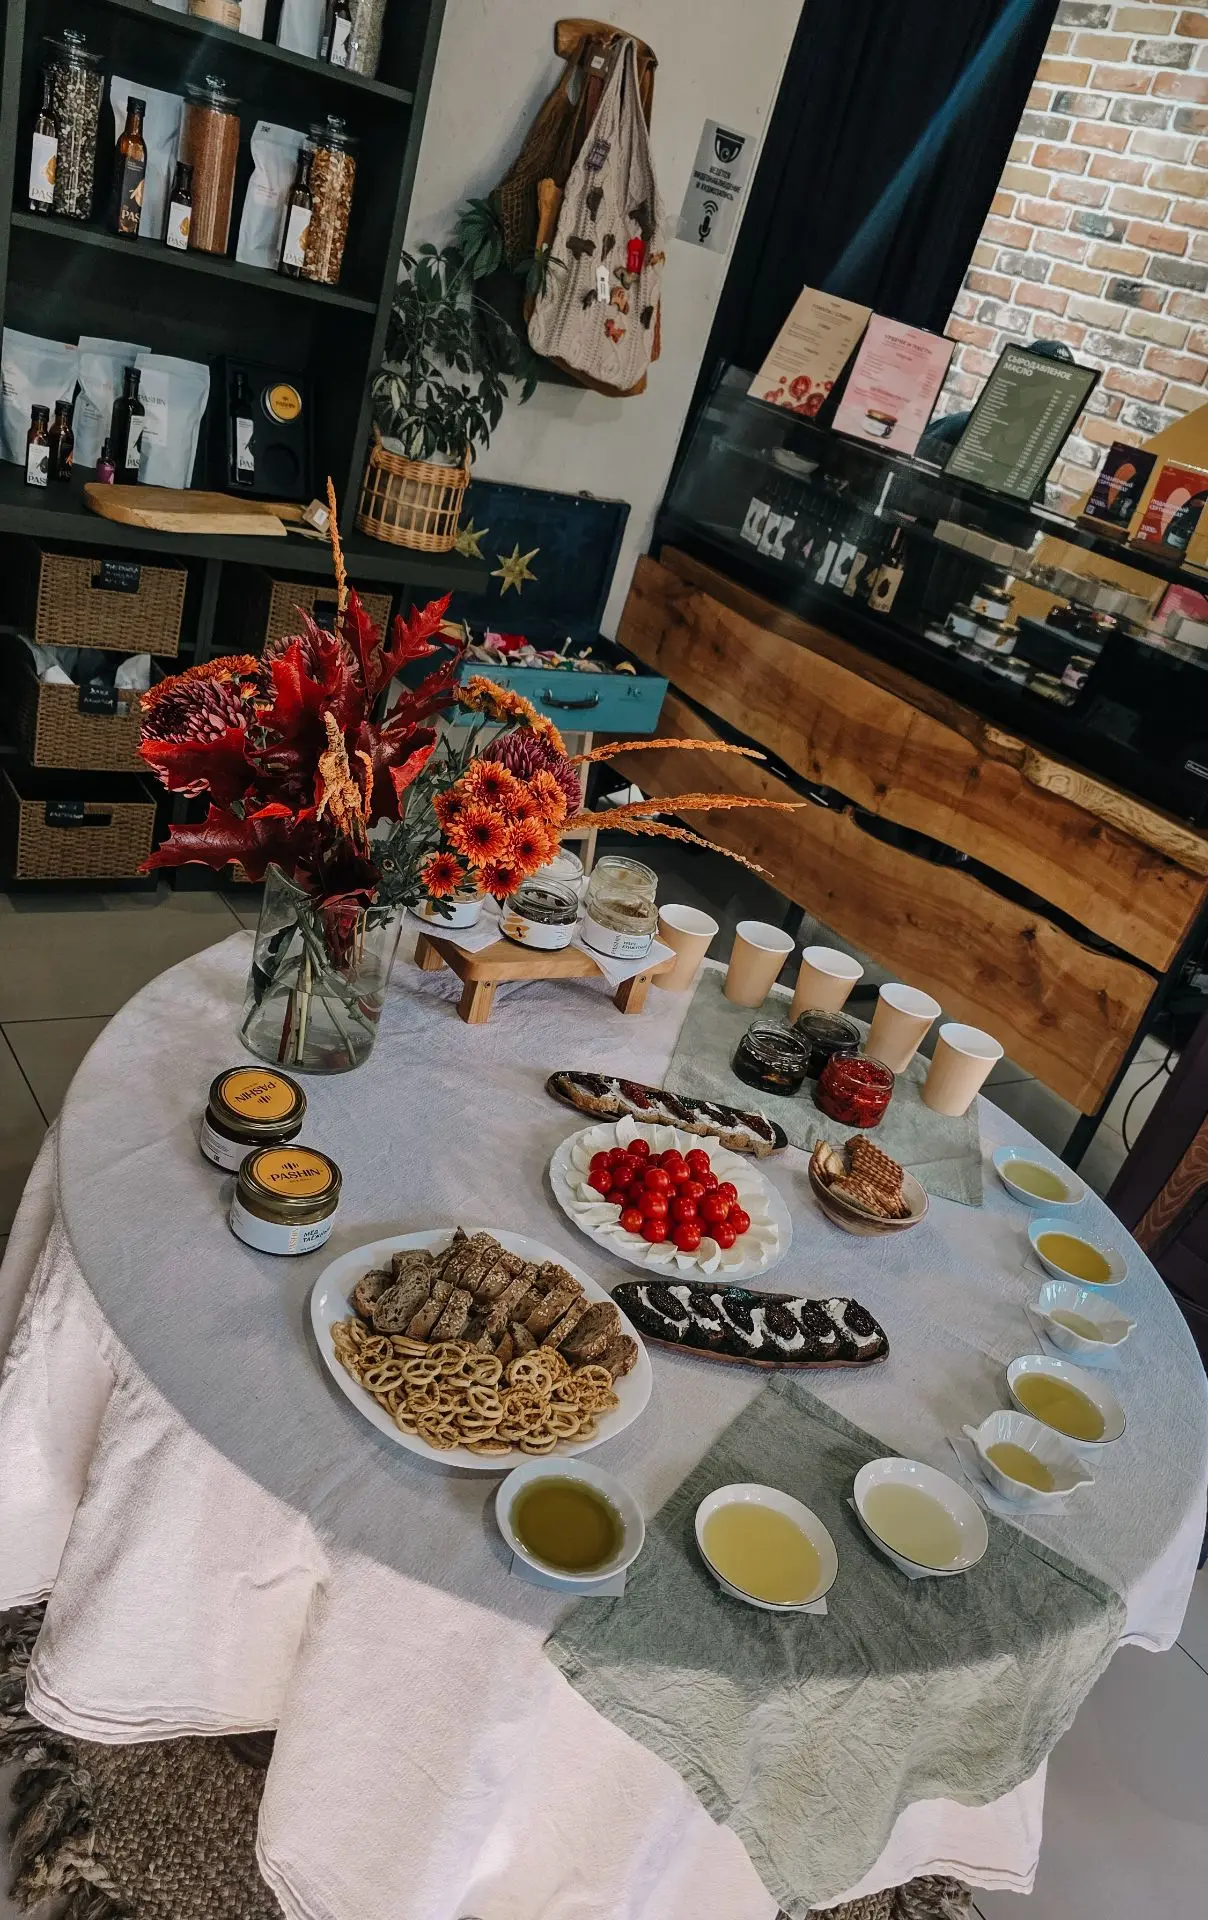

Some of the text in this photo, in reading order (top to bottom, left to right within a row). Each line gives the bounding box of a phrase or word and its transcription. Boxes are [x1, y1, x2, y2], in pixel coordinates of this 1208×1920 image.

[1002, 362, 1034, 377] МАСЛО
[235, 1081, 276, 1102] PASHIN
[270, 1168, 320, 1181] PASHIN
